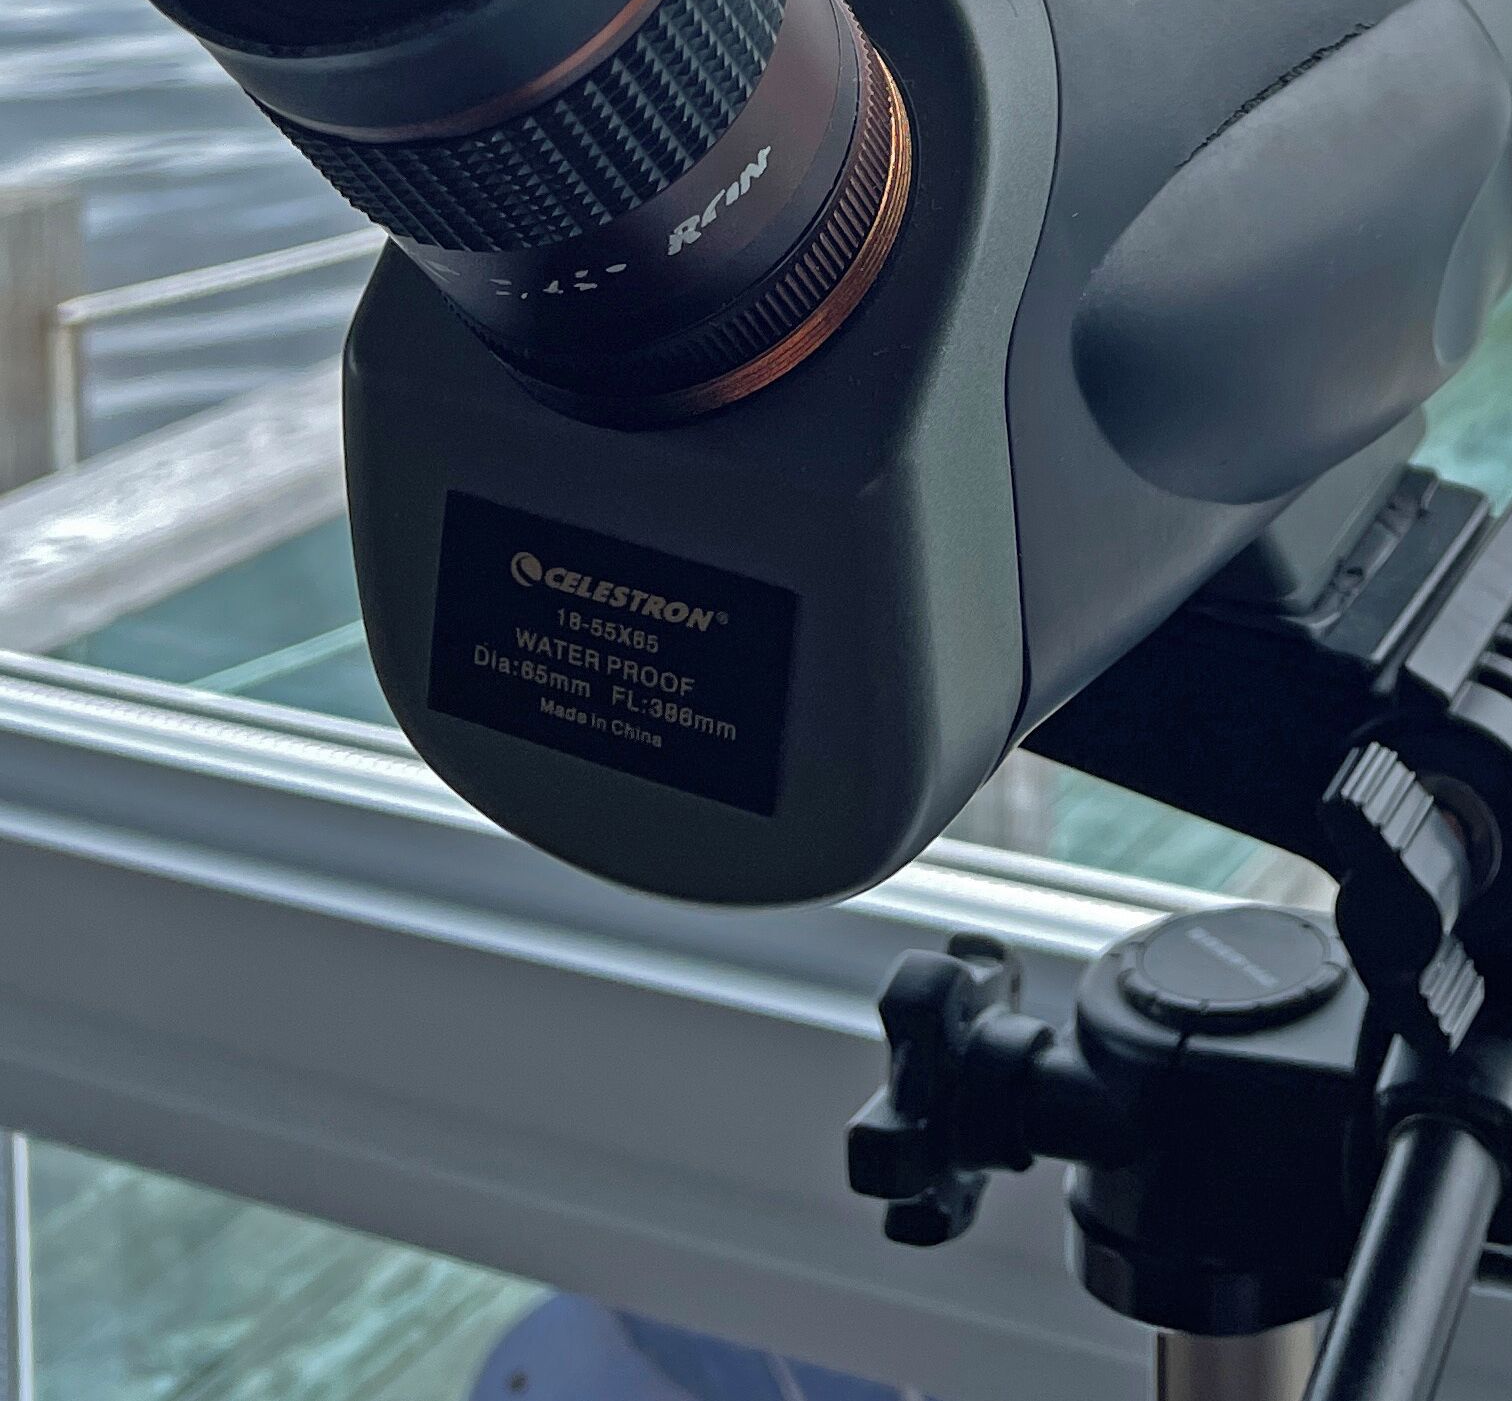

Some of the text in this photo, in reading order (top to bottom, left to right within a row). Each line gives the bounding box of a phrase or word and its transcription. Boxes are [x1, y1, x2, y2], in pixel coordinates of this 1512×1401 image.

[515, 627, 696, 697] WATER PROOF
[540, 696, 588, 725] Made
[611, 719, 663, 749] China
